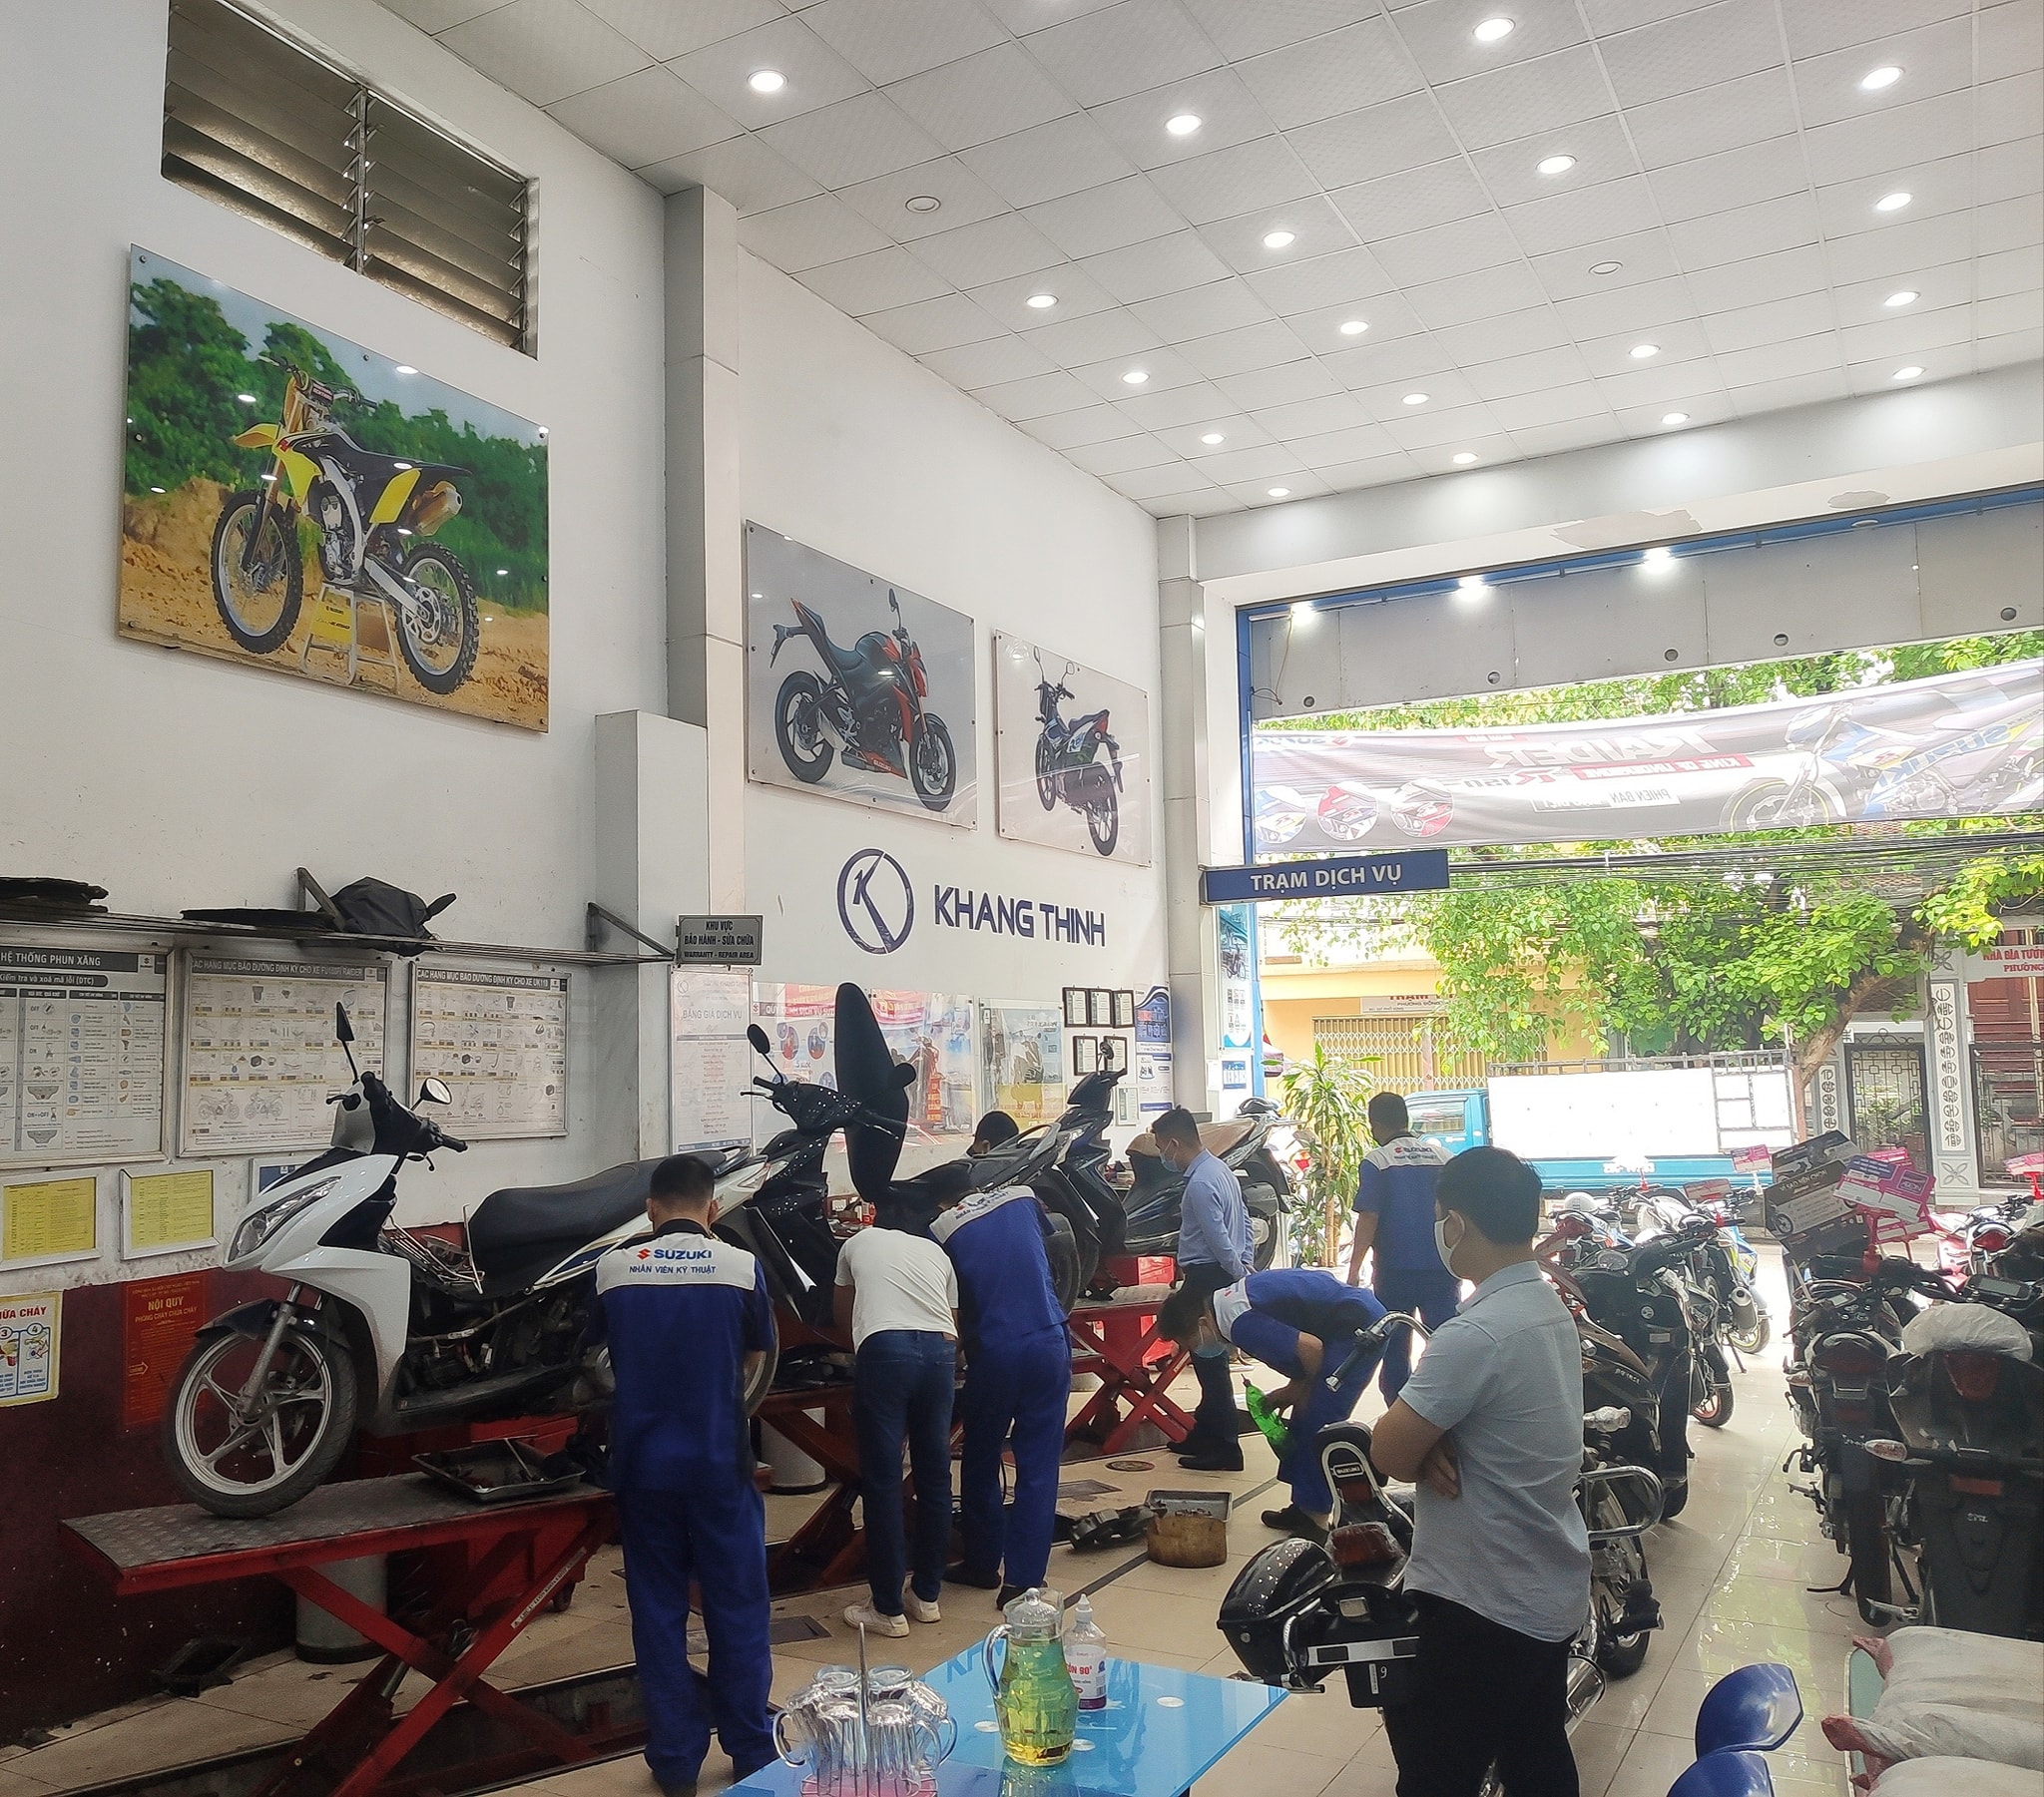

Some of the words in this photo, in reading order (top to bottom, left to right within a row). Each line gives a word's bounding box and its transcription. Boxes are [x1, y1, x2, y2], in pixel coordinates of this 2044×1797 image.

[1251, 871, 1307, 894] TRẠM
[1315, 867, 1365, 890] DỊCH
[1370, 863, 1402, 886] VỤ
[934, 884, 1035, 938] KHANG
[1039, 902, 1106, 947] THINH
[706, 920, 720, 931] KHU
[720, 919, 734, 933] VỰC
[684, 932, 697, 945] BẢO
[699, 933, 717, 945] HÀNH
[722, 932, 736, 945] SỬA
[737, 932, 755, 945] CHỮA
[1, 950, 13, 964] HỆ
[16, 950, 47, 965] THỐNG
[50, 955, 74, 966] PHUN
[77, 955, 101, 967] XĂNG
[18, 974, 28, 983] tra
[76, 975, 95, 986] (DTC)
[683, 1008, 703, 1020] BẢNG
[654, 1249, 713, 1260] SUZUKI
[629, 1264, 653, 1274] NHÂN
[655, 1265, 674, 1274] VIÊN
[691, 1264, 717, 1275] THUẬT
[148, 1297, 164, 1312] NỘI
[166, 1295, 185, 1309] QUY
[20, 1305, 47, 1318] CHÁY
